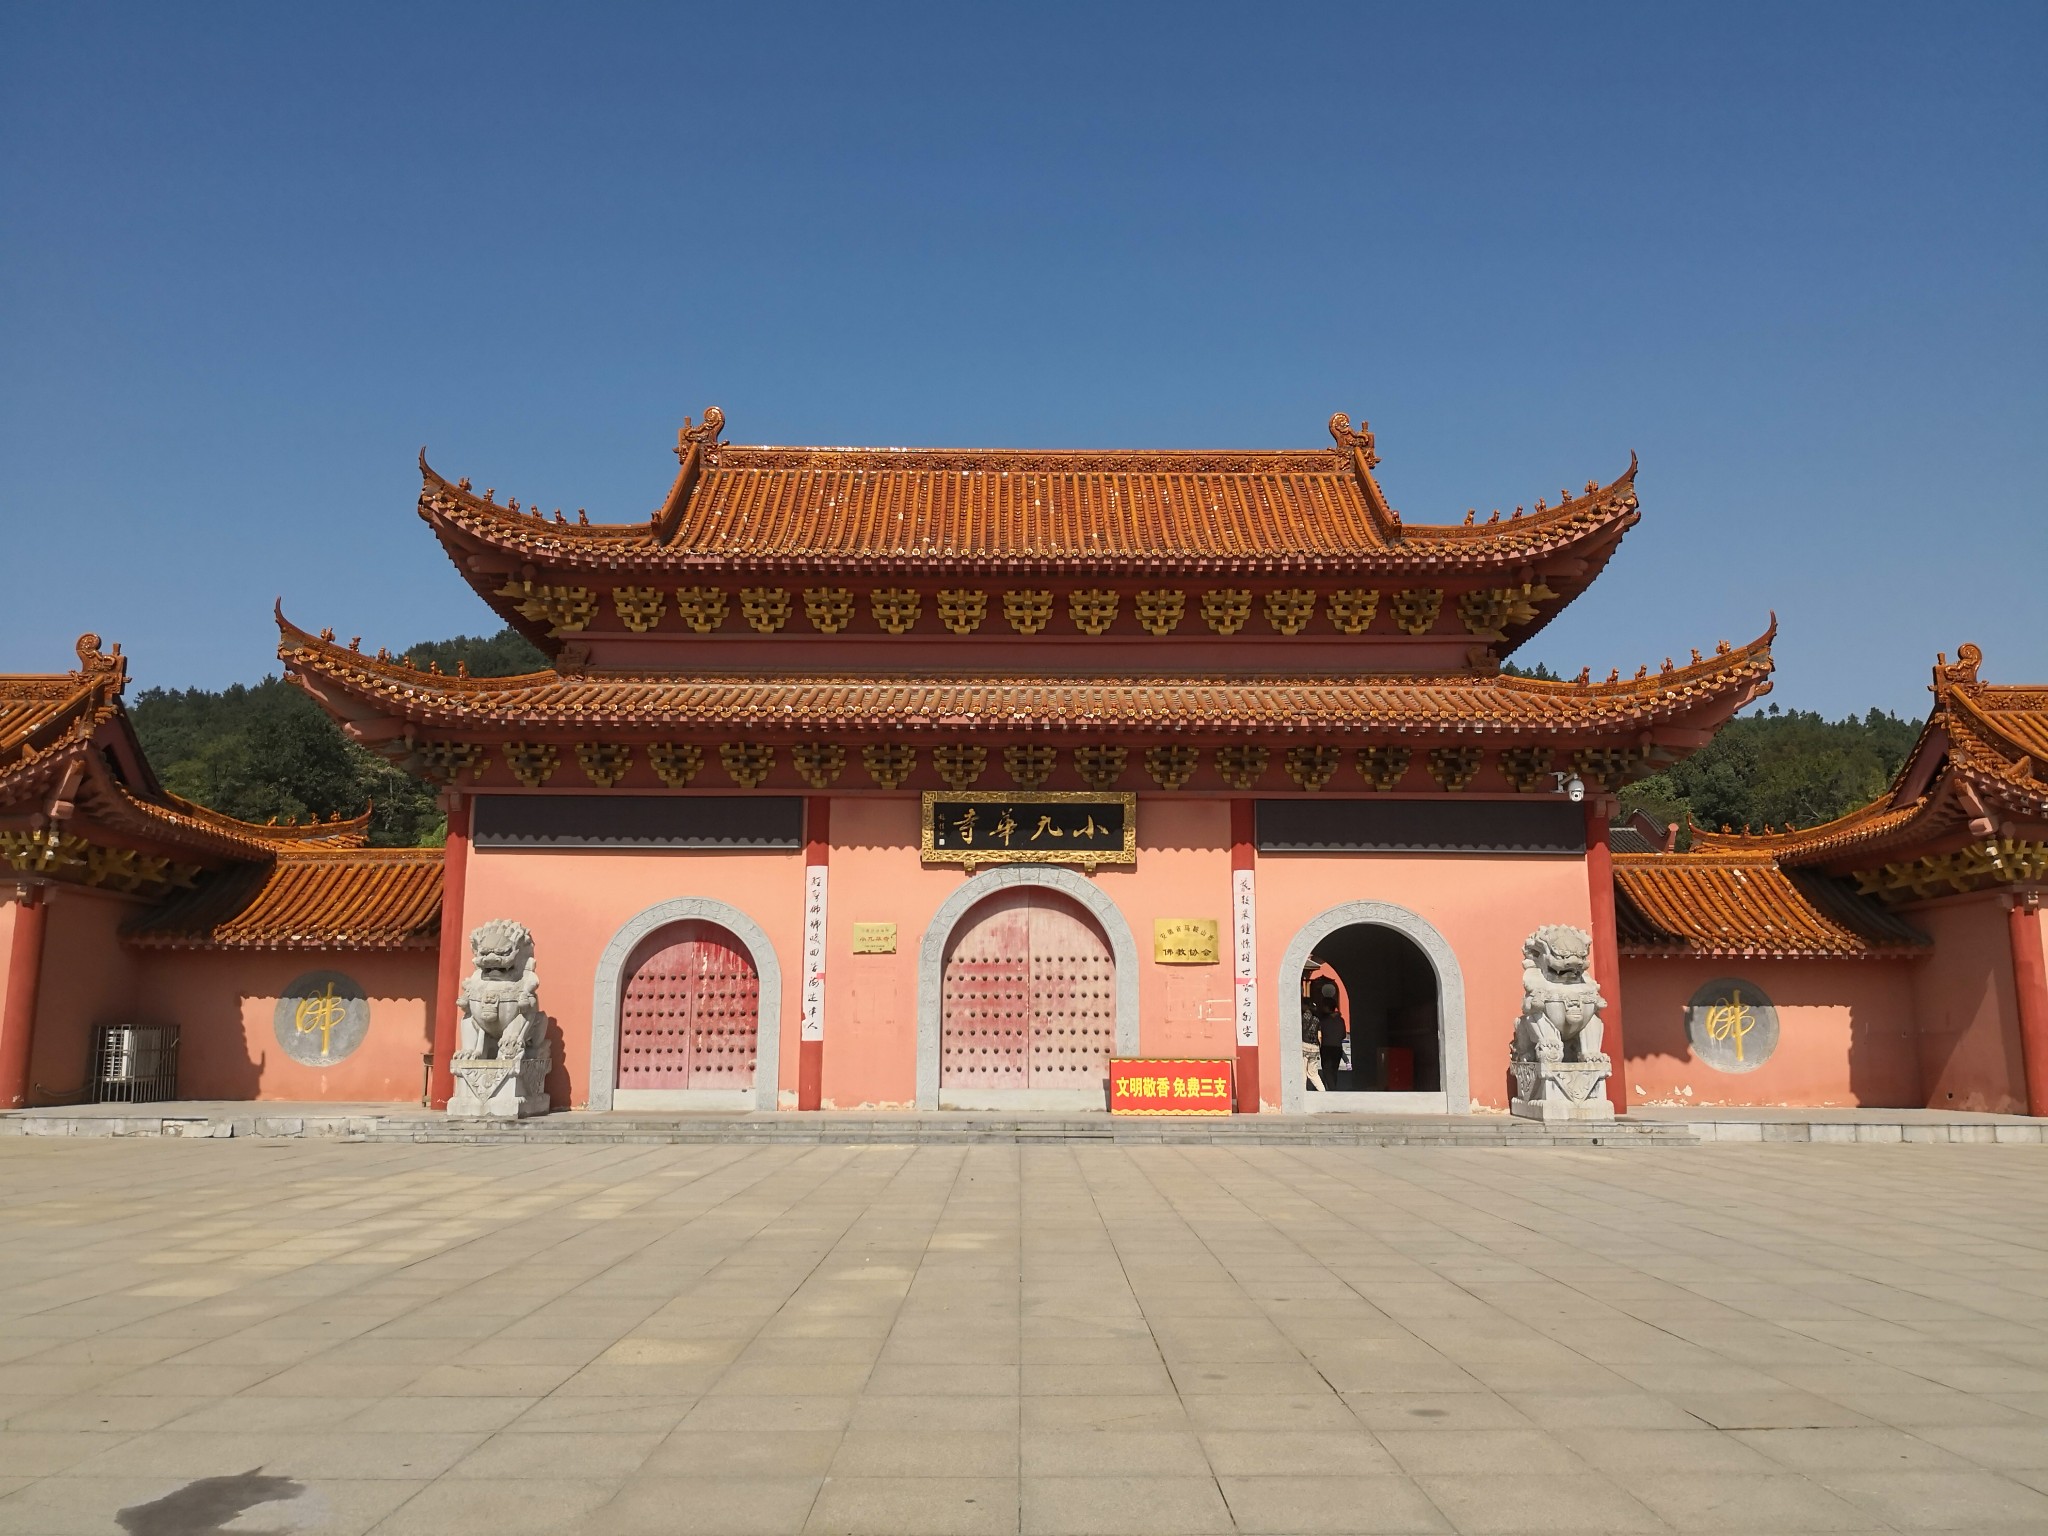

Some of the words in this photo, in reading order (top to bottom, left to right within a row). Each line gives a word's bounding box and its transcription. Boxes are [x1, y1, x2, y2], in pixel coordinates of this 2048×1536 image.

[1162, 948, 1212, 957] 佛教协会
[1116, 1077, 1170, 1098] 文明敬香
[1173, 1077, 1227, 1098] 免费三支
